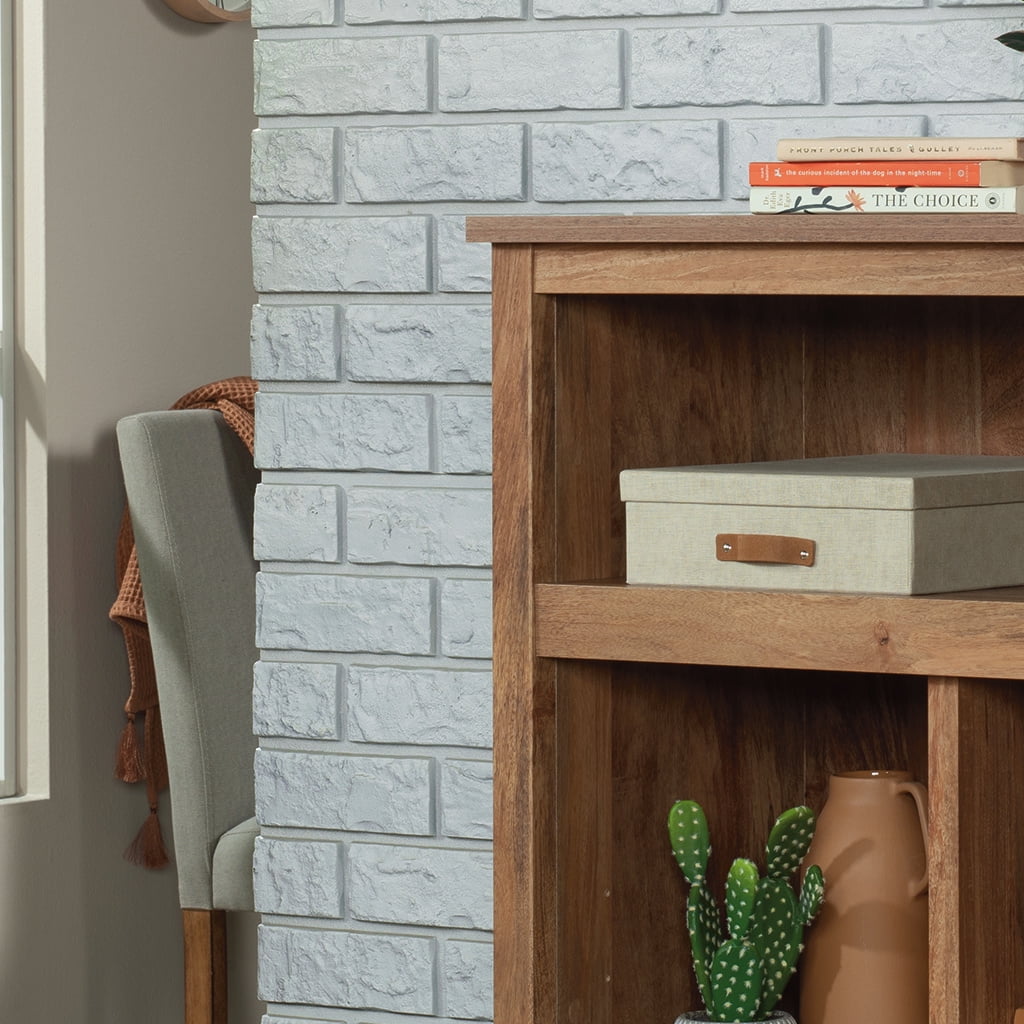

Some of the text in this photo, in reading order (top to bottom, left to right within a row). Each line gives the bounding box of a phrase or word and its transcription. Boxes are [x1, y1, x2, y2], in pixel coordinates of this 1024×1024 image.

[872, 169, 885, 177] dog
[907, 169, 942, 177] night-time
[871, 194, 979, 208] THE CHOICE
